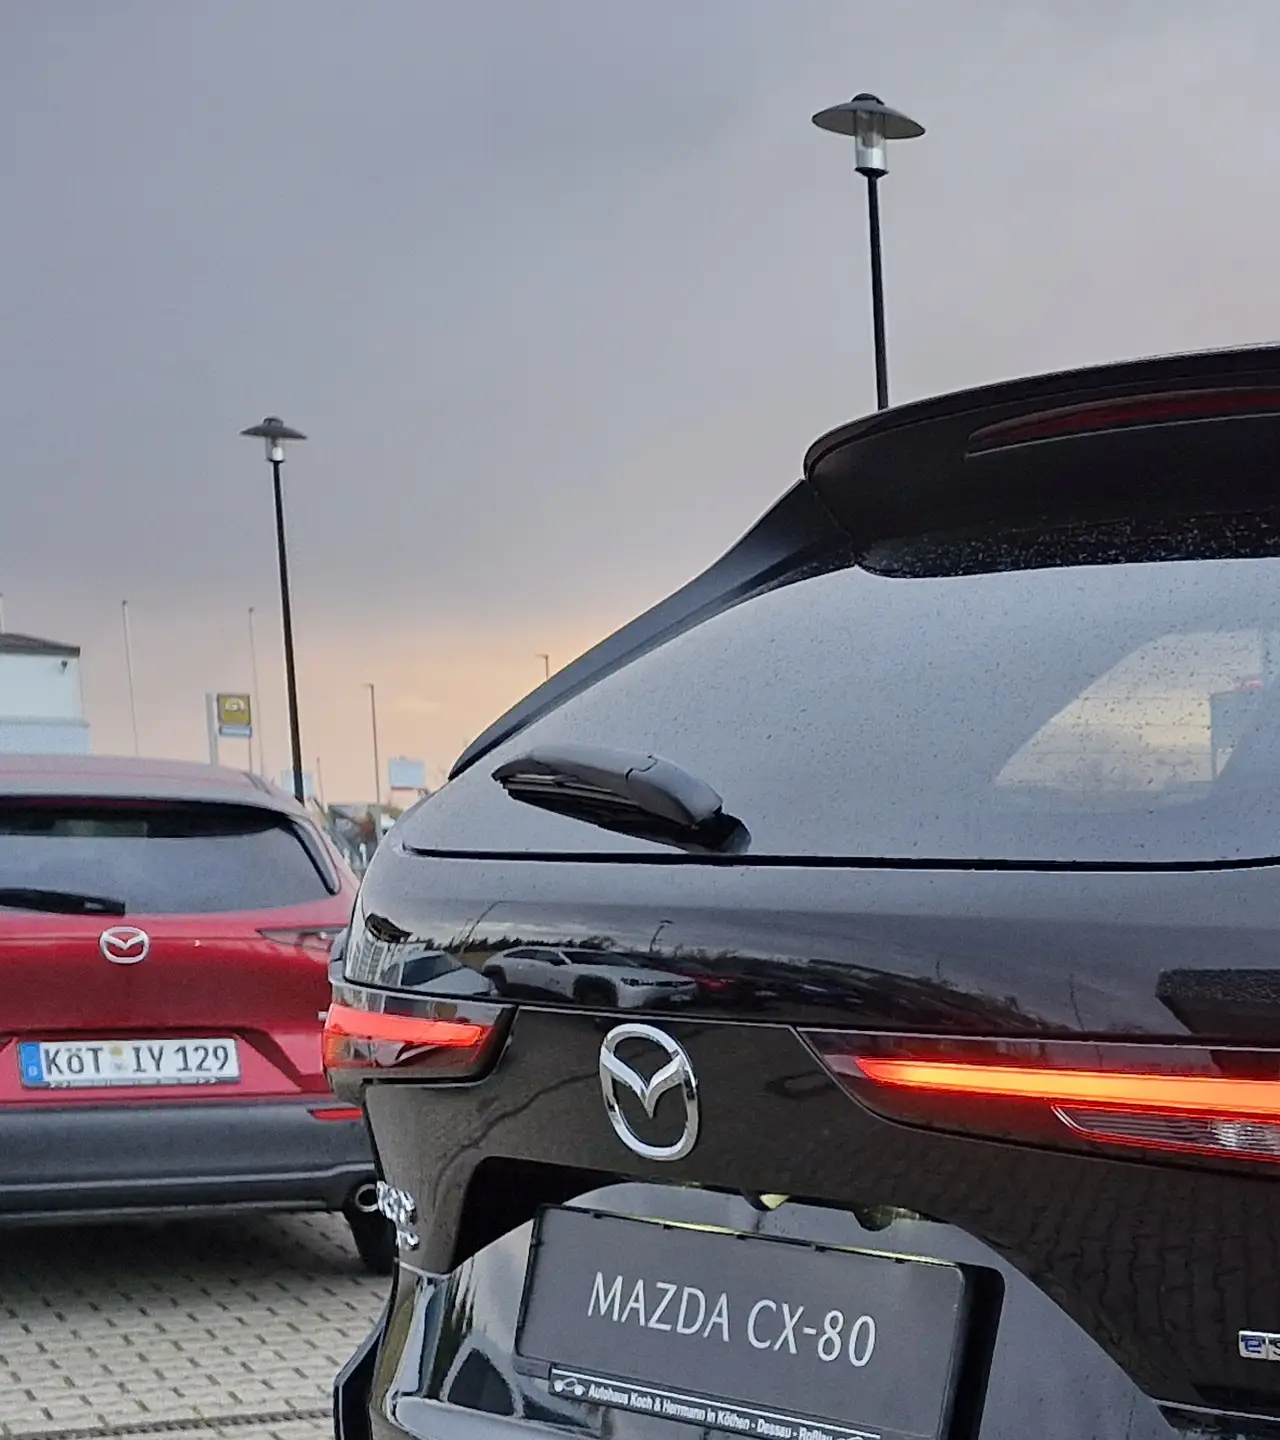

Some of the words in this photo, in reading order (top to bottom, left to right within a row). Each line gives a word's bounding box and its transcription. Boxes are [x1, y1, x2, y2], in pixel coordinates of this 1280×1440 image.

[131, 1046, 164, 1072] IY
[174, 1045, 229, 1072] 129
[587, 1271, 730, 1343] MAZDA
[747, 1299, 877, 1368] CX-80
[588, 1383, 629, 1405] Autohaus
[629, 1391, 653, 1410] Koch
[653, 1397, 661, 1412] &
[662, 1399, 706, 1421] Herrmann
[717, 1410, 750, 1429] Köthen
[756, 1418, 793, 1438] Dessau
